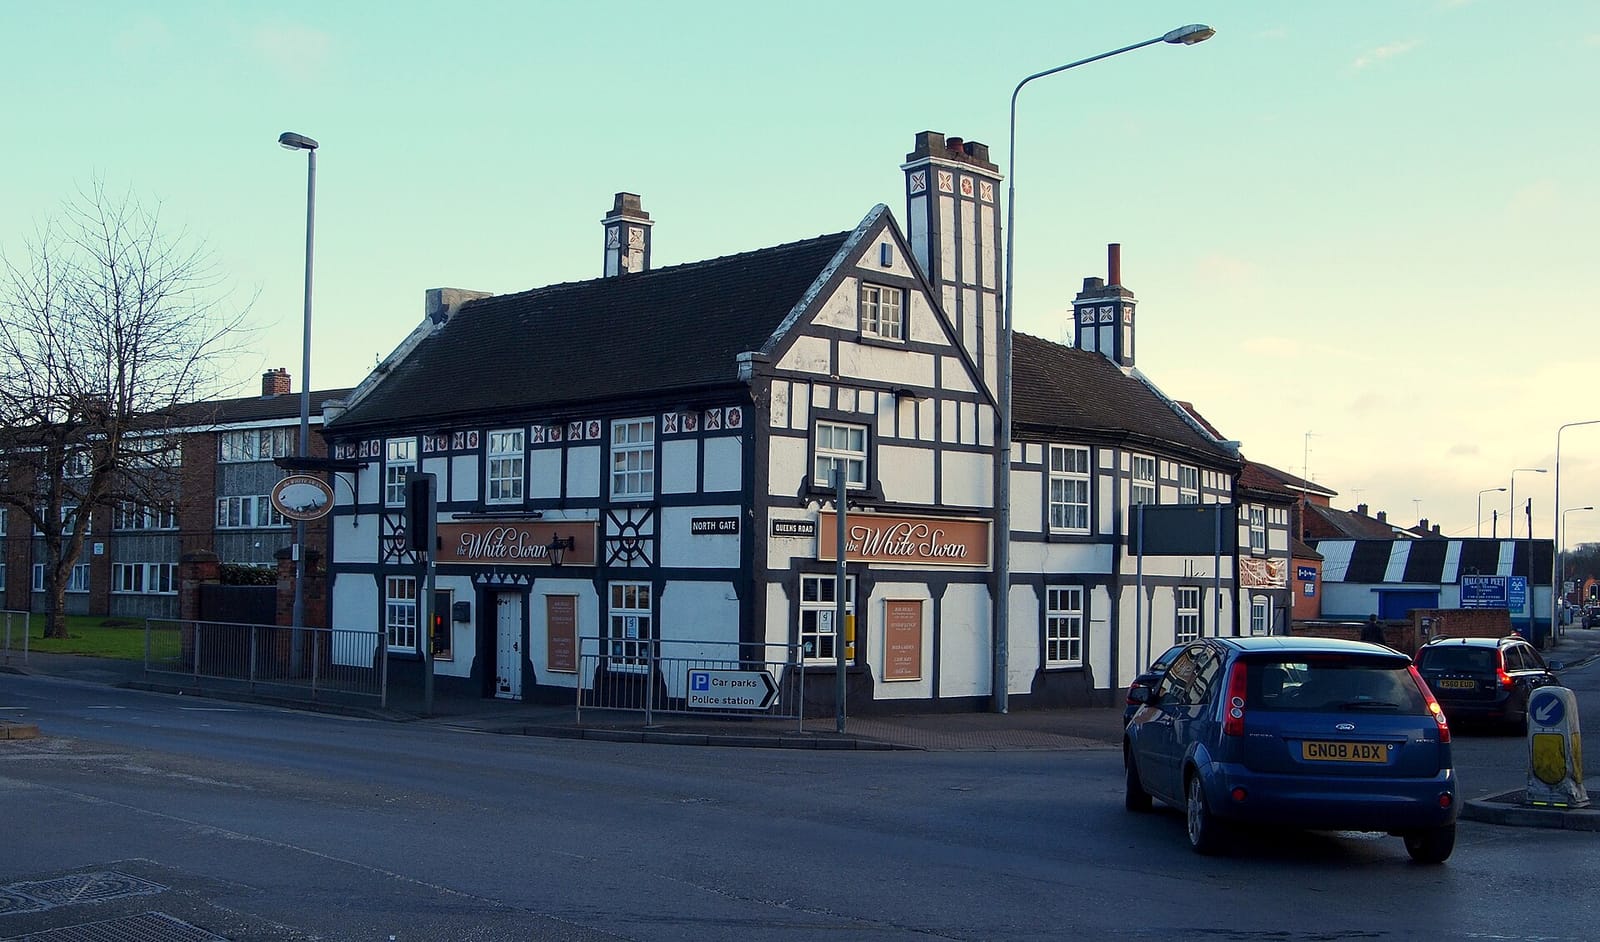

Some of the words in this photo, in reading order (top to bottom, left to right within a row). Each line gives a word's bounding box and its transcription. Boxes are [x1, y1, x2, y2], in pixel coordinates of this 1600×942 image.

[692, 521, 716, 531] NORTH
[719, 520, 736, 530] GATE
[775, 523, 797, 533] QUEENS
[797, 523, 813, 533] ROAD
[460, 526, 517, 559] White
[509, 532, 548, 559] Swan
[851, 522, 929, 556] White
[918, 529, 968, 558] Swan
[456, 545, 467, 556] the
[696, 675, 707, 690] P
[712, 678, 728, 687] Car
[731, 679, 757, 688] parks
[692, 695, 719, 704] Police
[721, 696, 755, 705] station
[1308, 743, 1348, 758] GN08
[1352, 744, 1381, 759] ADX
